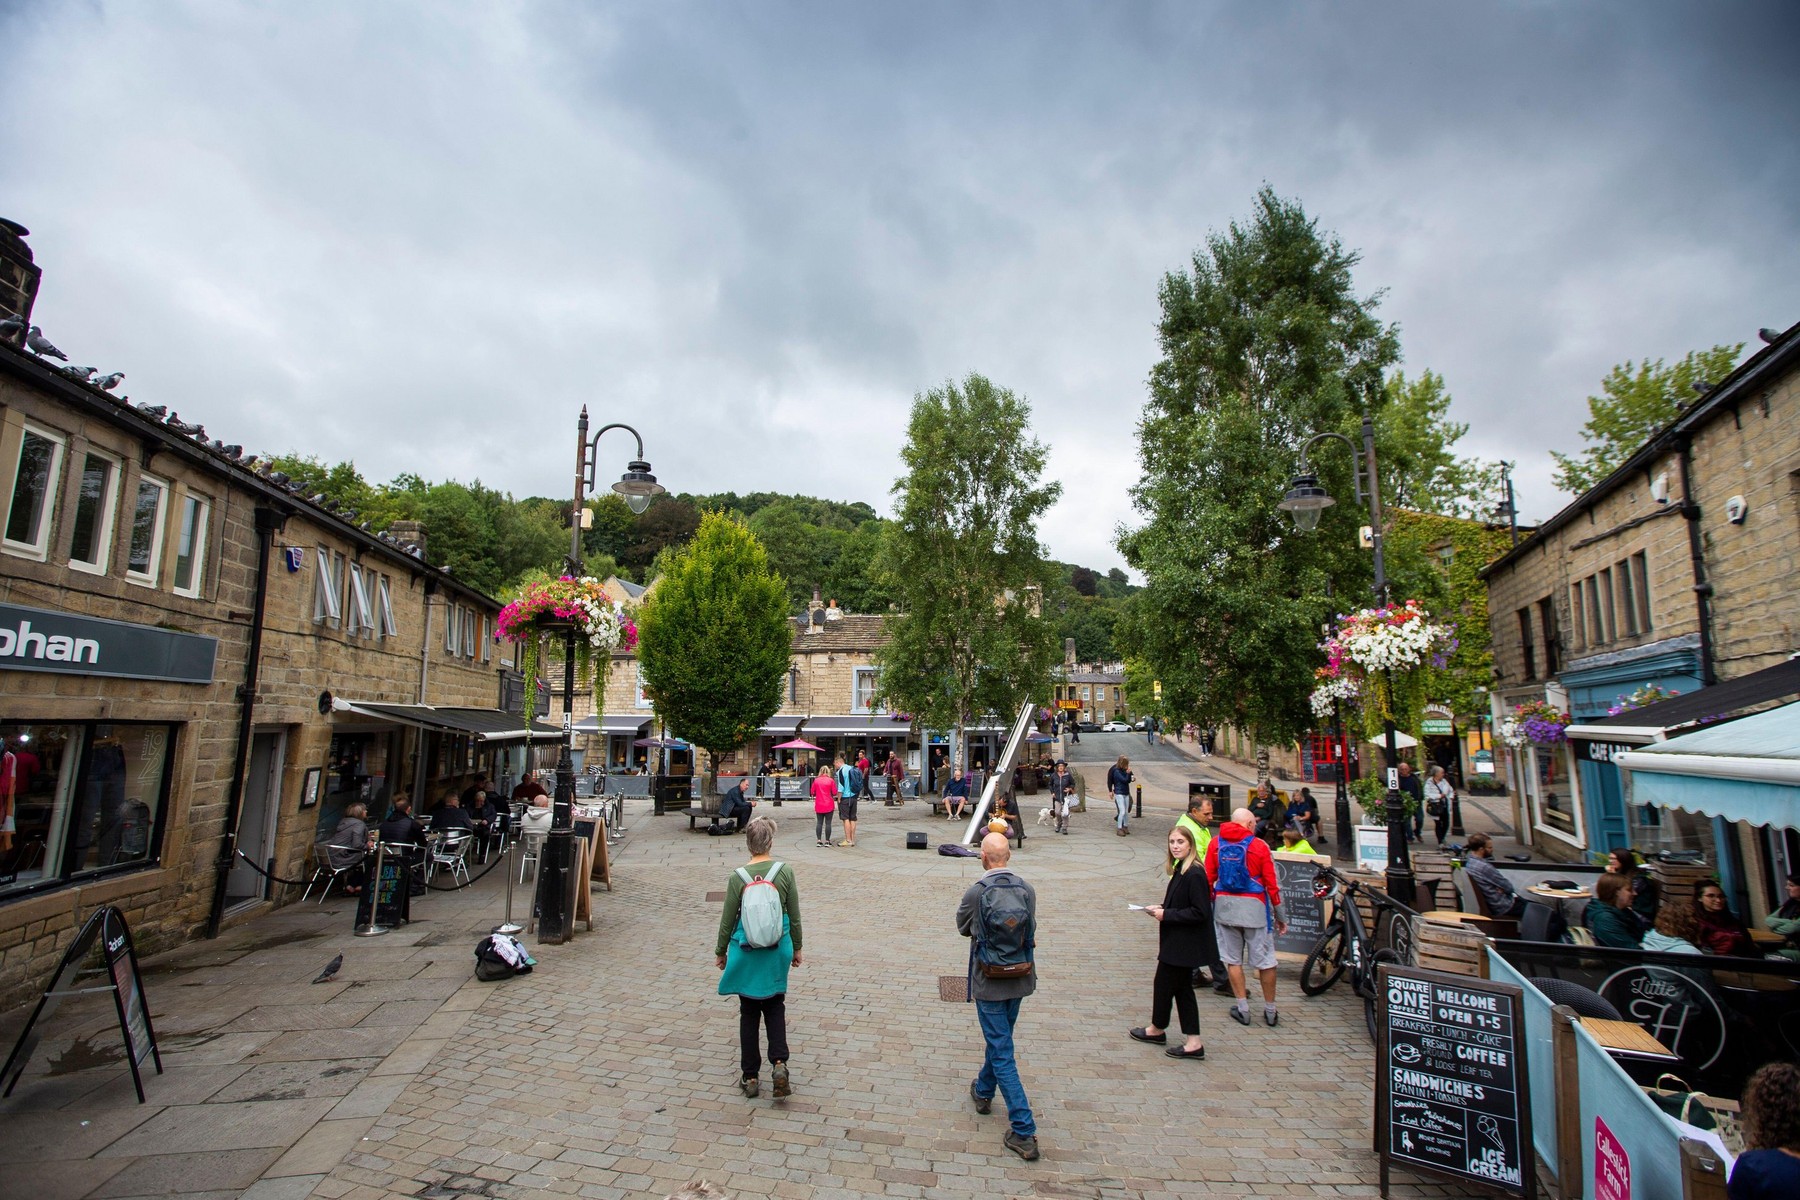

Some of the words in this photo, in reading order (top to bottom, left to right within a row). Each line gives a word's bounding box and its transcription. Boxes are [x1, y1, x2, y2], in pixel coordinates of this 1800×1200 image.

[1589, 741, 1608, 762] CAFE
[1390, 769, 1398, 789] 18
[1368, 846, 1388, 855] OPE
[1388, 979, 1429, 994] SQUARE
[1630, 976, 1679, 999] Little
[1388, 988, 1430, 1010] ONE
[1388, 1003, 1416, 1013] COFFEE
[1436, 989, 1498, 1012] WELCOME
[1439, 1008, 1472, 1025] OPEN
[1392, 1017, 1437, 1034] BREAKFAST
[1441, 1026, 1468, 1041] LUNCH
[1476, 1032, 1502, 1047] CAKE
[1421, 1037, 1453, 1051] FRESHLY
[1456, 1045, 1507, 1067] COFFEE
[1425, 1058, 1433, 1067] &
[1435, 1060, 1456, 1072] LOOSE
[1460, 1064, 1477, 1076] LEAF
[1479, 1069, 1493, 1080] TEA
[1393, 1069, 1486, 1100] SANDWICHES
[1394, 1082, 1430, 1099] PANINI
[1400, 1113, 1420, 1127] Iced
[1420, 1117, 1445, 1132] Coffee
[1481, 1146, 1506, 1166] ICE
[1469, 1158, 1520, 1182] CREAM
[1603, 1158, 1621, 1199] Farm
